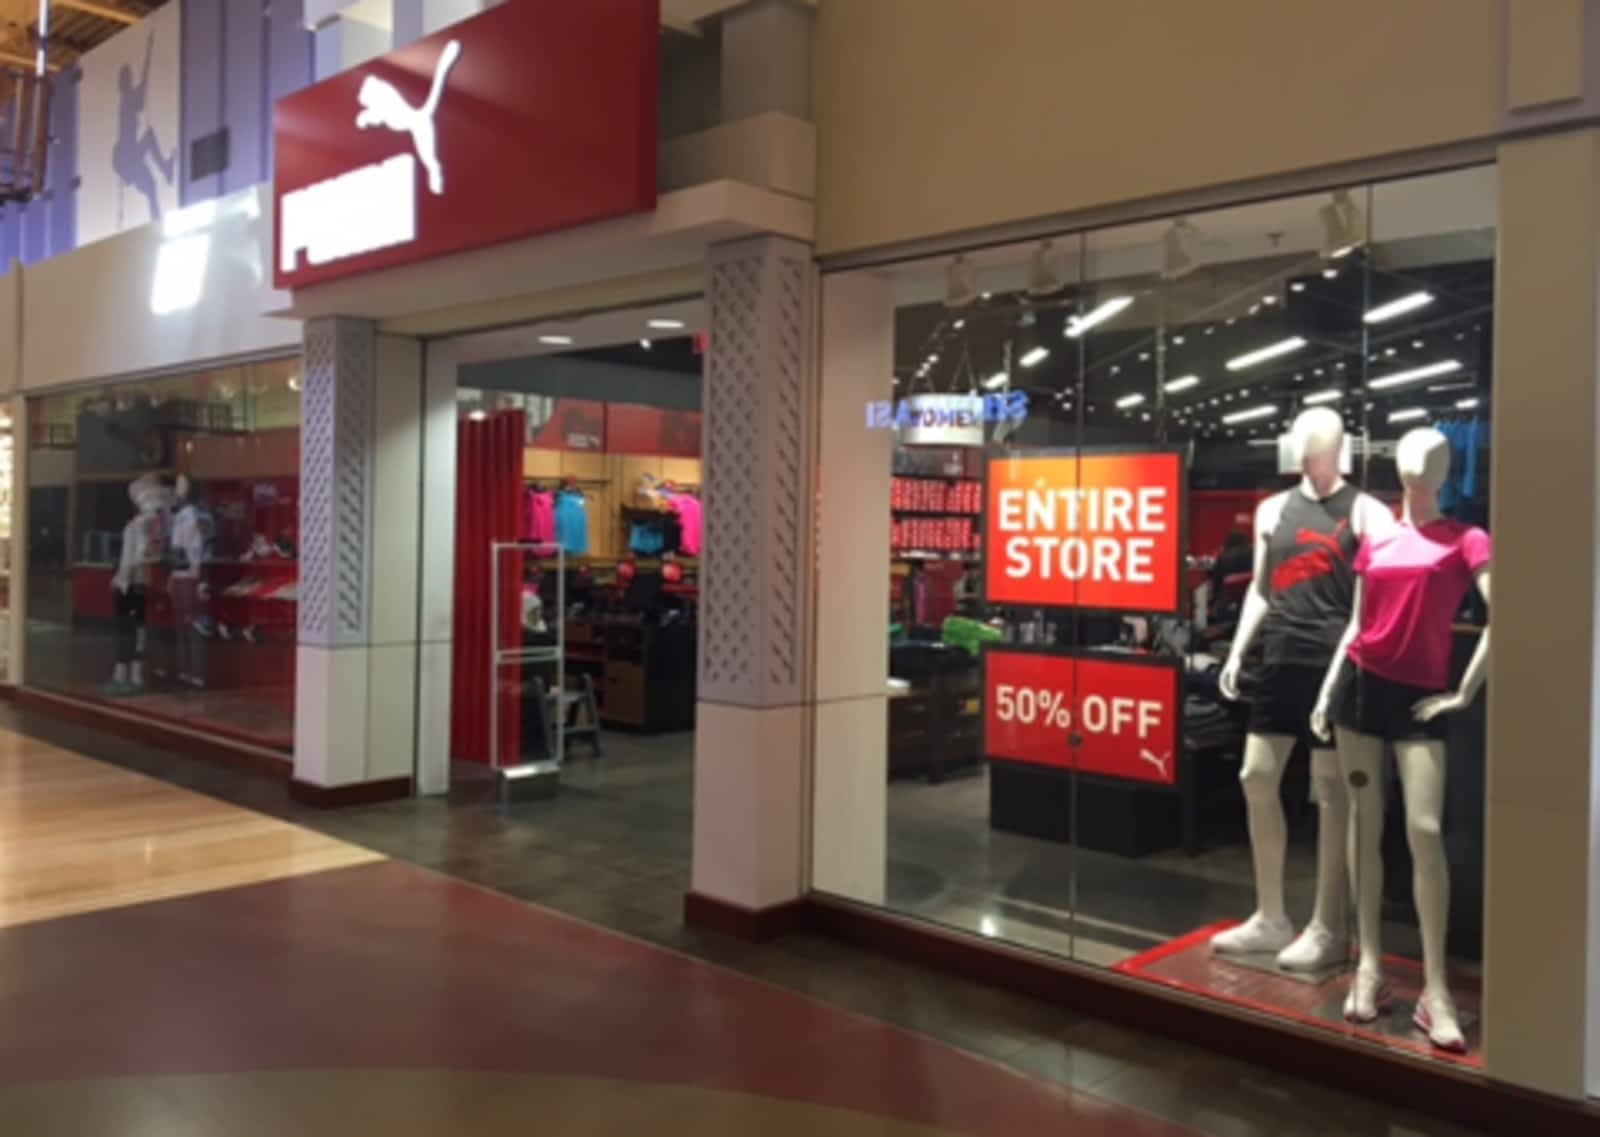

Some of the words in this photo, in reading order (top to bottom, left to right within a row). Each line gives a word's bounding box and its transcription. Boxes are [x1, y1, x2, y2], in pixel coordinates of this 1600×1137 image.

[998, 485, 1167, 533] ENTIRE
[1004, 535, 1155, 583] STORE
[995, 685, 1071, 729] 50%
[1082, 694, 1163, 739] OFF
